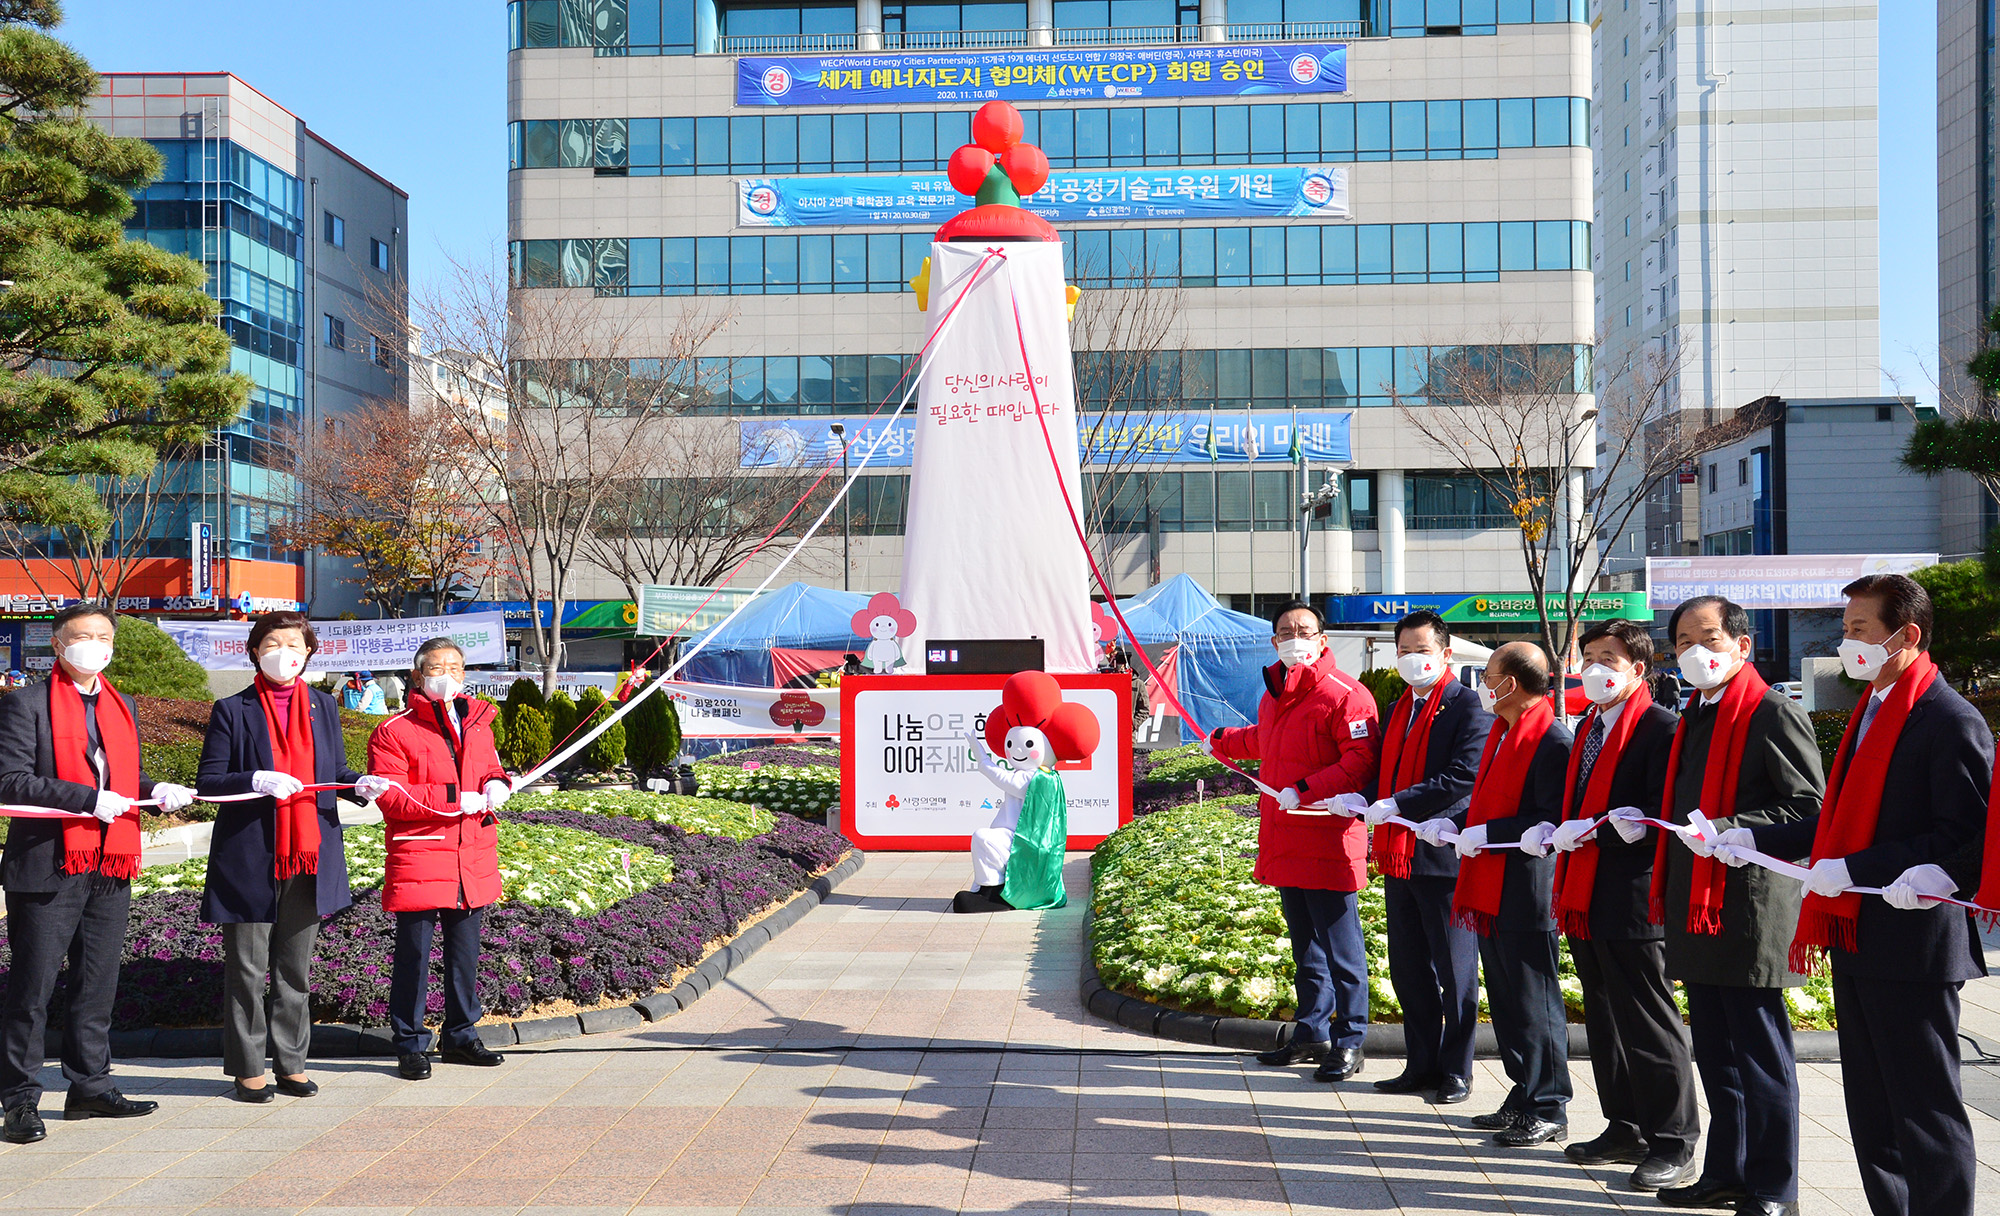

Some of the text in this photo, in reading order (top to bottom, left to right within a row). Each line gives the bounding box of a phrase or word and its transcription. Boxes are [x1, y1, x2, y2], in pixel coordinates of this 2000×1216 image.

[819, 58, 871, 68] WECP(World
[872, 57, 901, 68] Energy
[903, 57, 926, 66] Cities
[928, 55, 980, 67] Partnership):
[981, 55, 1006, 65] 15개국
[1007, 54, 1024, 64] 19개
[1025, 54, 1050, 64] 에너지
[1051, 53, 1083, 62] 선도도시
[1085, 52, 1101, 62] 연합
[1109, 51, 1136, 61] 의장국:
[1187, 49, 1214, 59] 사무국:
[1216, 48, 1263, 58] 휴스턴(미국)
[817, 59, 1265, 90] 세계 에너지도시 협의체(WECP) 회원 승인
[1296, 59, 1315, 79] 축
[768, 72, 785, 91] 경
[937, 91, 959, 99] 2020.
[911, 181, 930, 192] 국내
[1020, 173, 1273, 204] 학공정기술교육원 개원
[1306, 180, 1328, 200] 축
[753, 191, 771, 212] 경
[798, 195, 956, 208] 아시아 2번째 화학공정 교육 전문기관
[929, 401, 1060, 425] 필요한 때입니다
[1373, 600, 1409, 615] NH
[694, 698, 738, 707] 희망2021
[691, 707, 742, 718] 나눔캠페인
[883, 713, 966, 741] 나눔으로
[958, 800, 972, 808] 후원
[1066, 798, 1110, 809] 보건복지부
